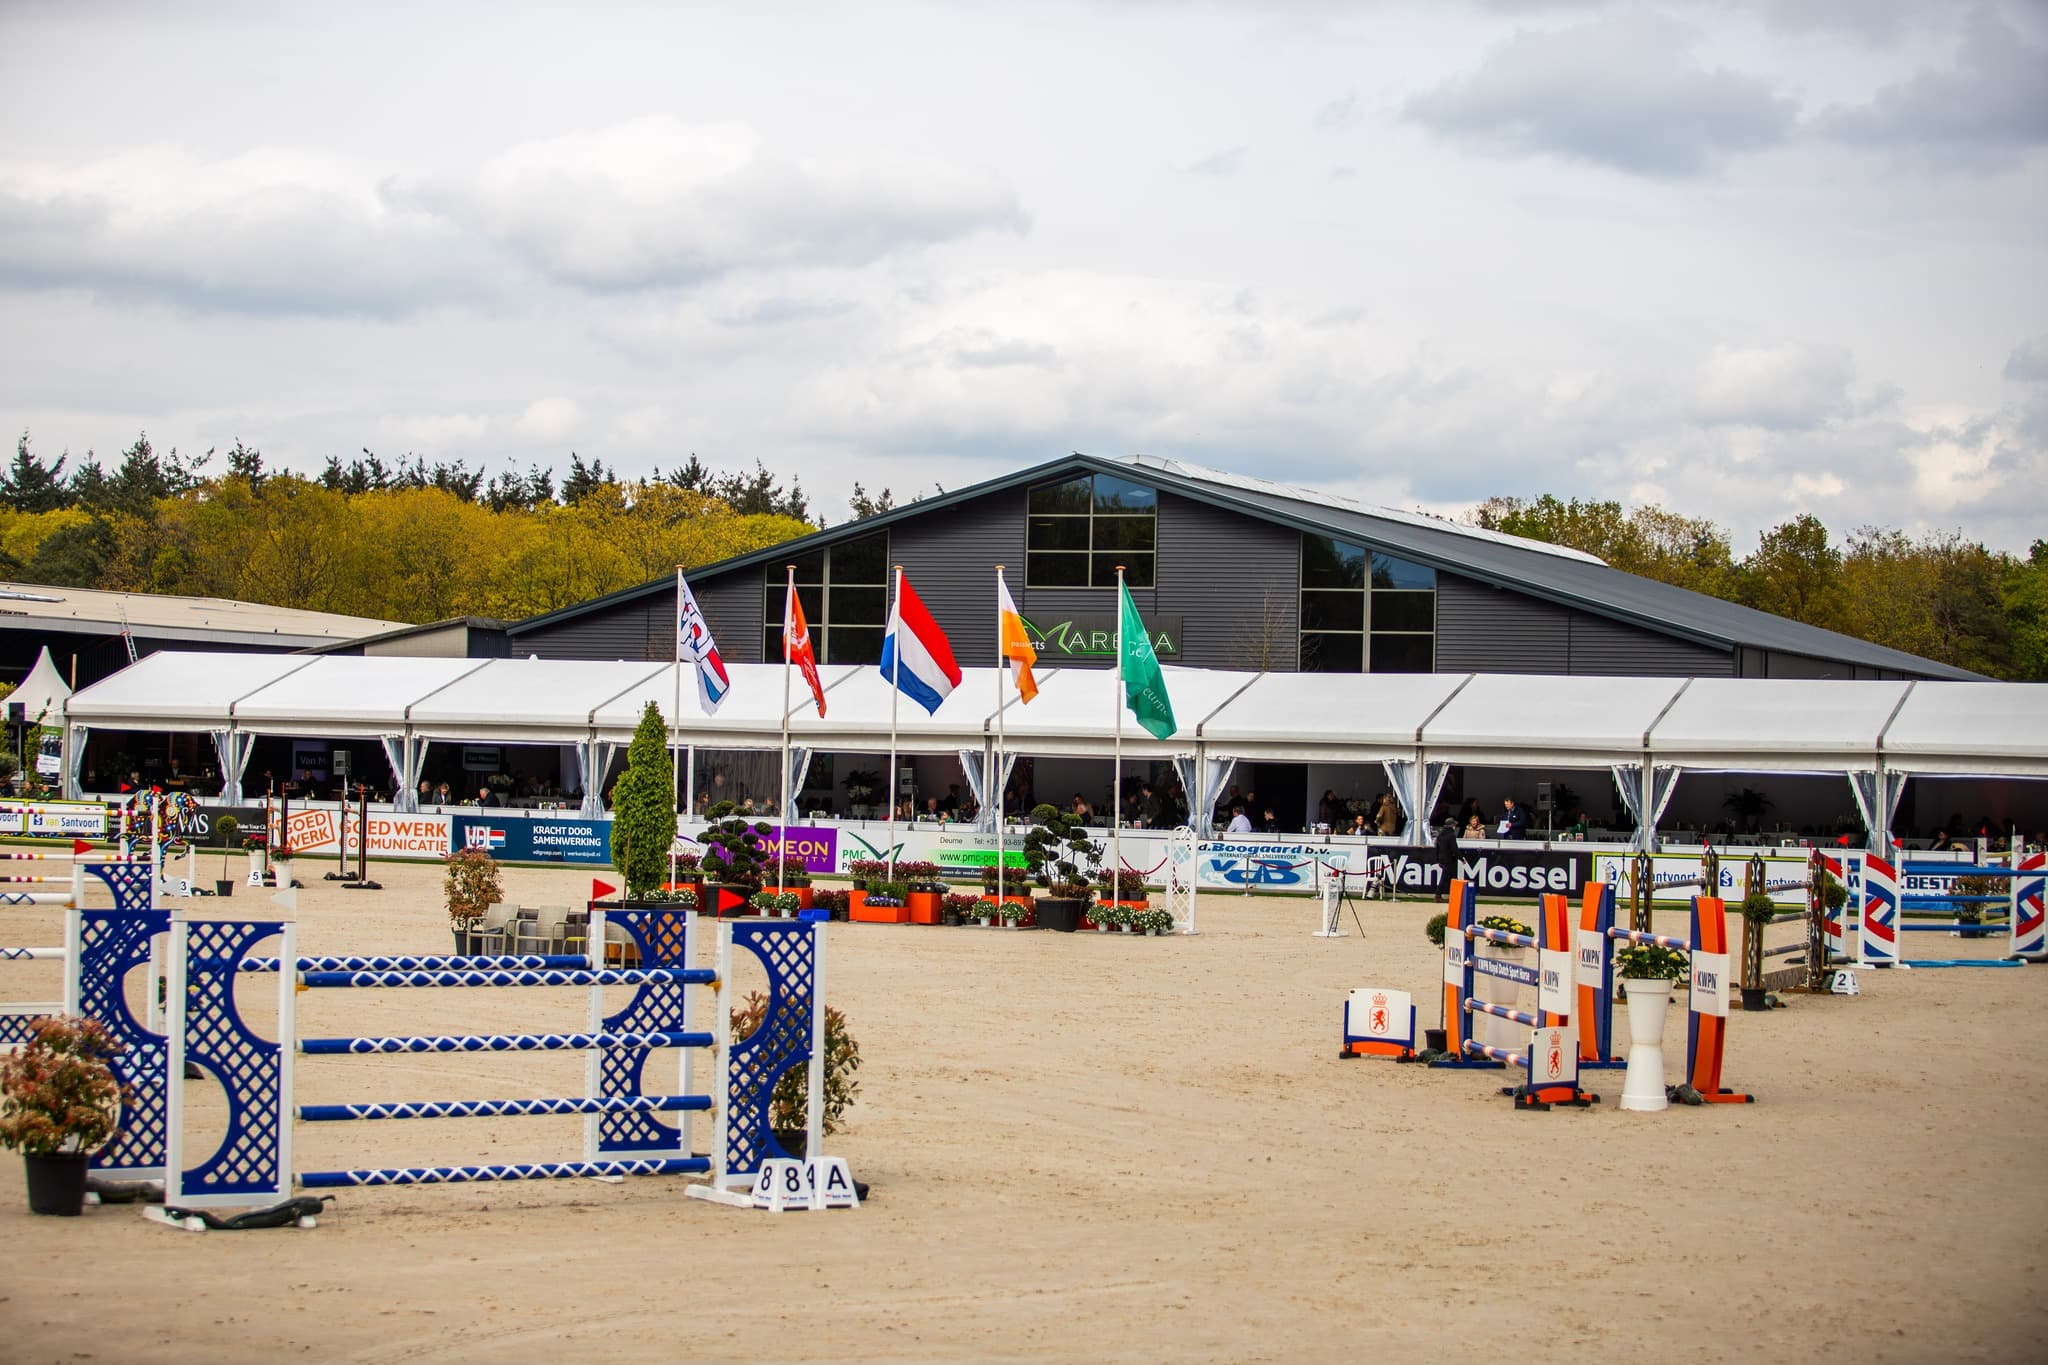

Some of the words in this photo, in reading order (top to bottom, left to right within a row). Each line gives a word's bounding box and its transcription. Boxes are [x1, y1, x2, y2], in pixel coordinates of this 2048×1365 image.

[1067, 631, 1174, 650] AREA
[0, 813, 18, 822] voort
[61, 817, 99, 828] Santvoort
[286, 813, 326, 834] GOED
[286, 827, 329, 847] WERK
[394, 822, 447, 837] WERK
[464, 825, 495, 850] VDL
[533, 825, 566, 835] KRACHT
[568, 826, 592, 836] DOOR
[533, 836, 601, 846] SAMENWERKING
[842, 849, 867, 860] PMC
[1305, 846, 1330, 855] b.v.
[252, 871, 259, 881] 5
[1379, 855, 1443, 886] Van
[1457, 857, 1577, 891] Mossel
[180, 881, 187, 891] 3
[1581, 947, 1600, 965] KWPN
[1697, 970, 1717, 989] KWPN
[1837, 973, 1846, 986] 2
[761, 1165, 772, 1191] 8
[785, 1167, 800, 1192] 8
[827, 1165, 847, 1190] A
